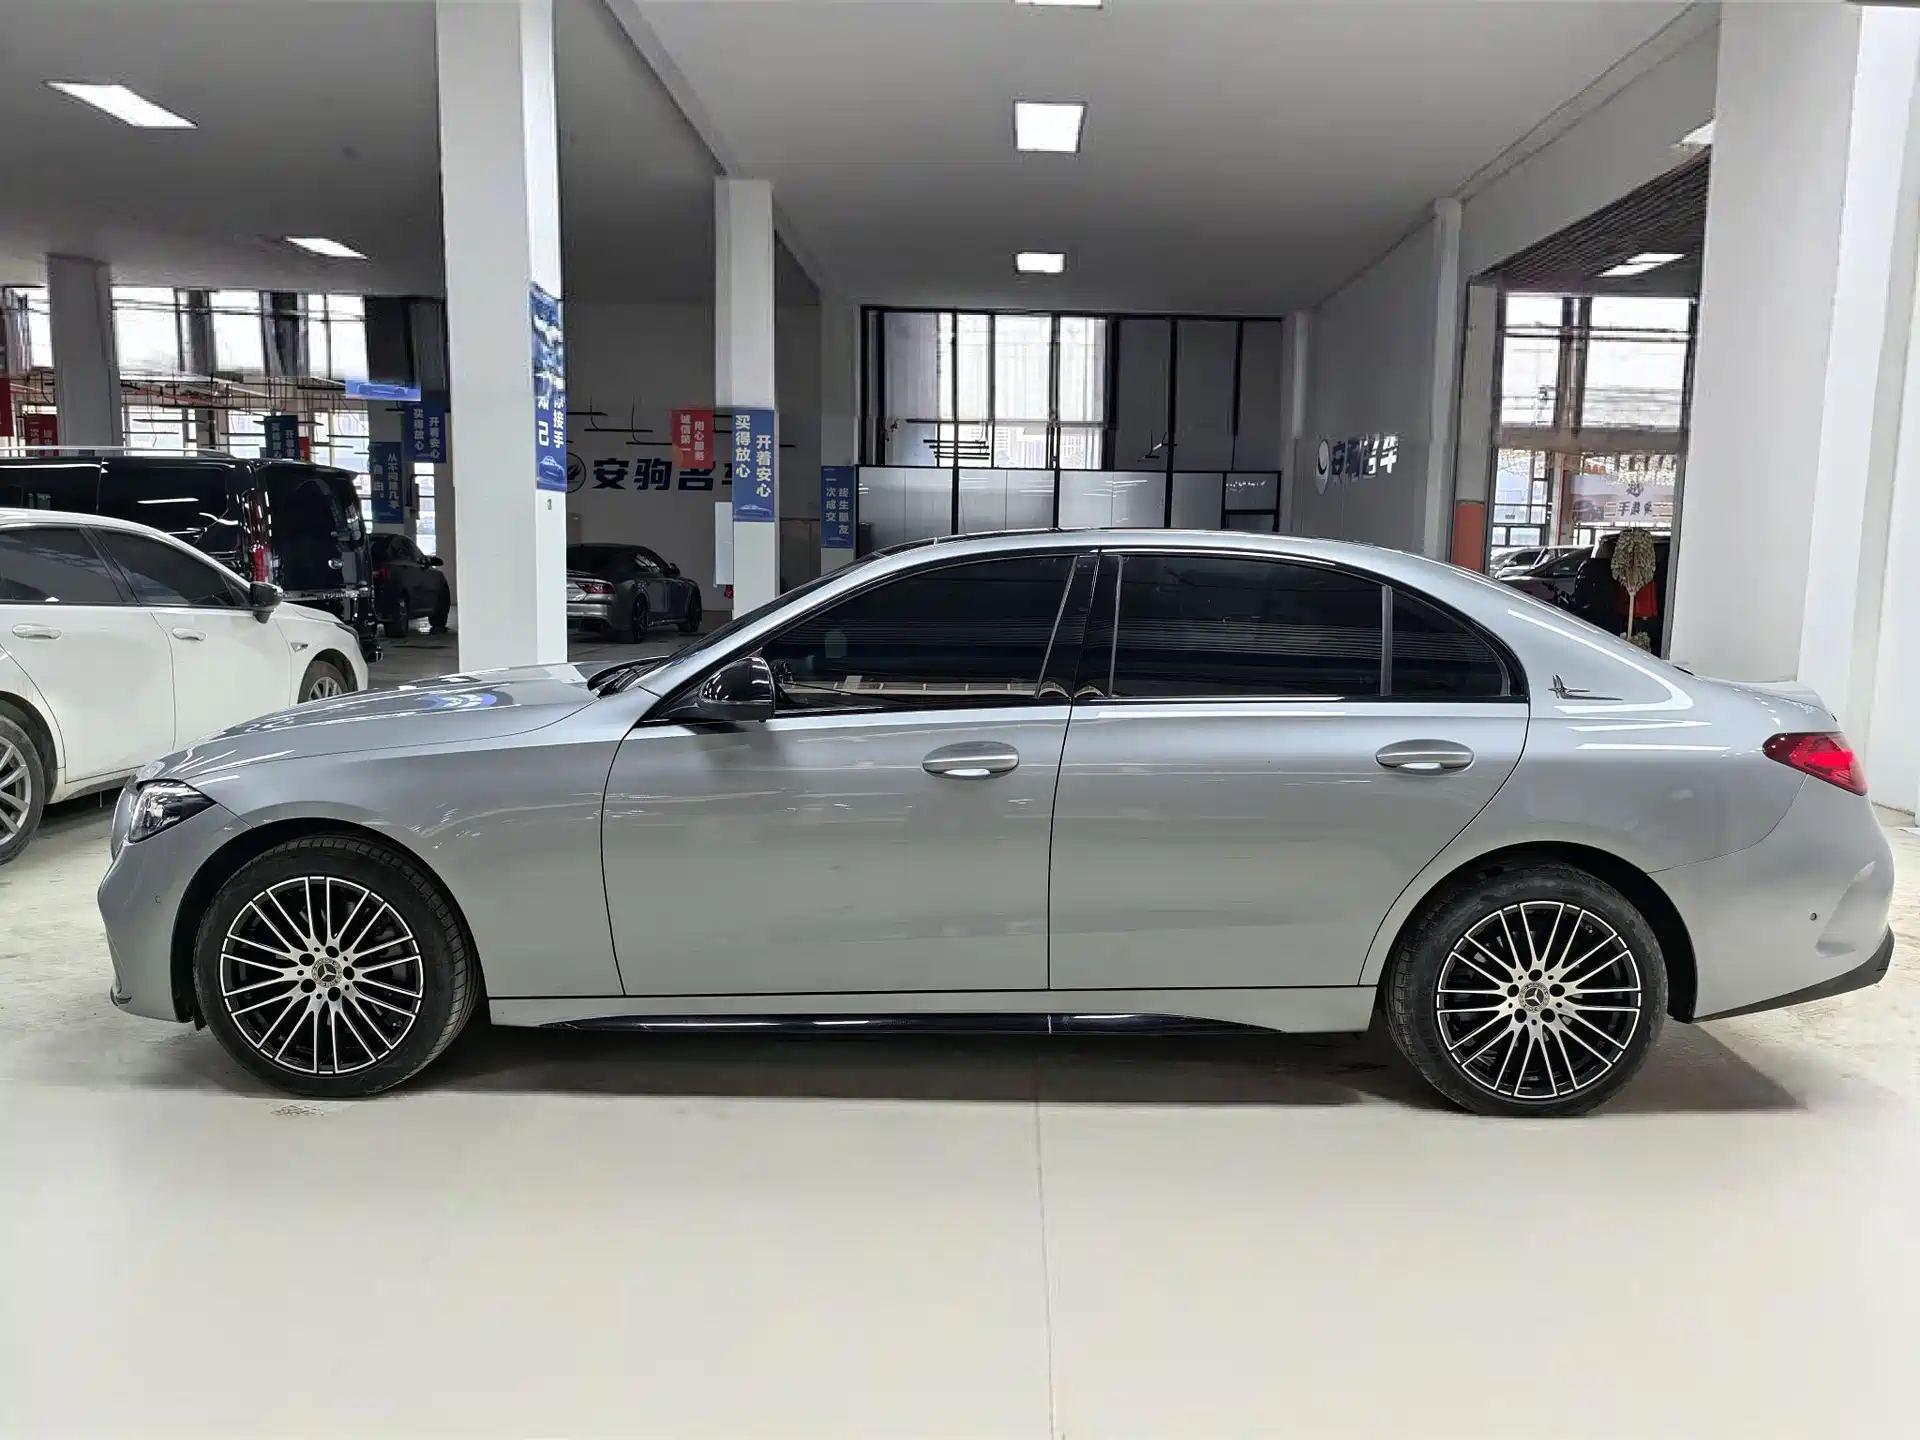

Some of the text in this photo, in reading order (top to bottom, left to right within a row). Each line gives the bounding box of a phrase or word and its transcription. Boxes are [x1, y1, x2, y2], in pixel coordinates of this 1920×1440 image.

[735, 415, 751, 478] 买得放心
[756, 435, 772, 498] 开着安心
